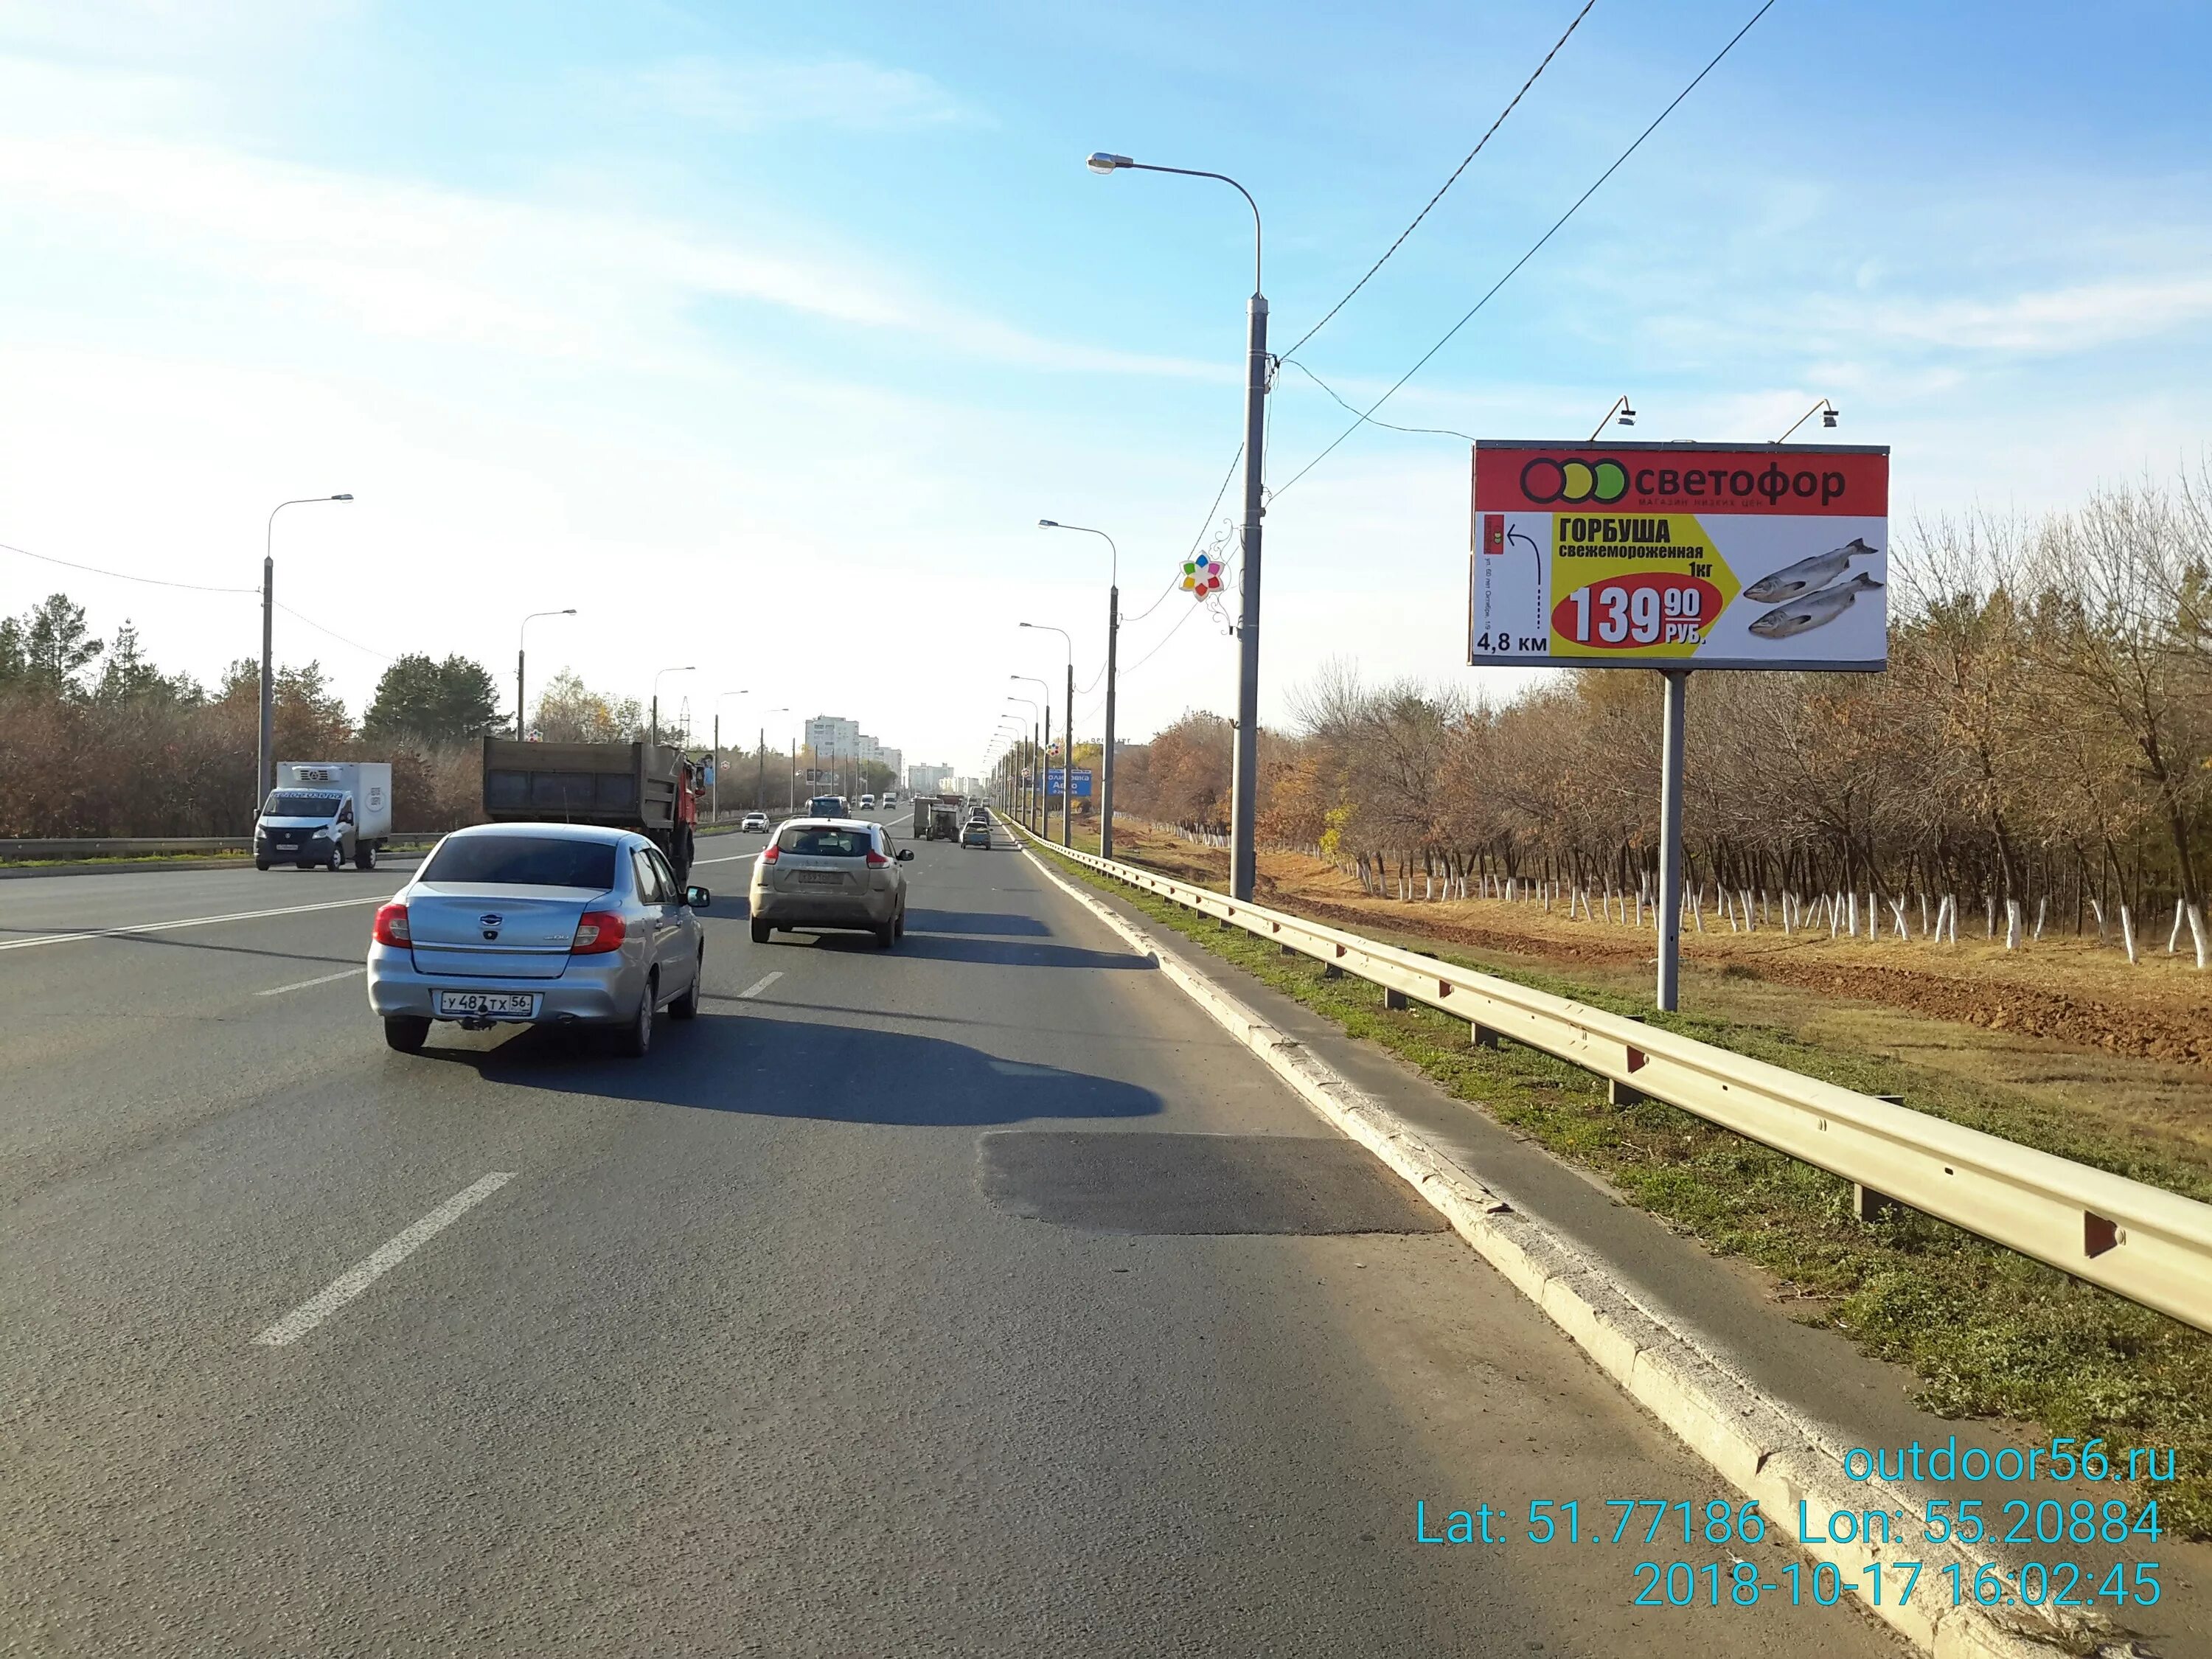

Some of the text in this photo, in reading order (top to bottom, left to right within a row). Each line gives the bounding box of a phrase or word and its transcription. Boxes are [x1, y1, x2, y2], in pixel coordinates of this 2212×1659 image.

[1635, 462, 1846, 506] светофор
[1638, 498, 1763, 508] МАГАЗИН НИЗКИХ ЦЕН
[1559, 518, 1671, 543] ГОРБУША
[1559, 544, 1703, 559] свежемороженная
[1688, 562, 1713, 578] 1кг
[1570, 587, 1702, 644] 139 90
[1477, 633, 1510, 654] 4,8
[1666, 624, 1706, 644] РУБ.
